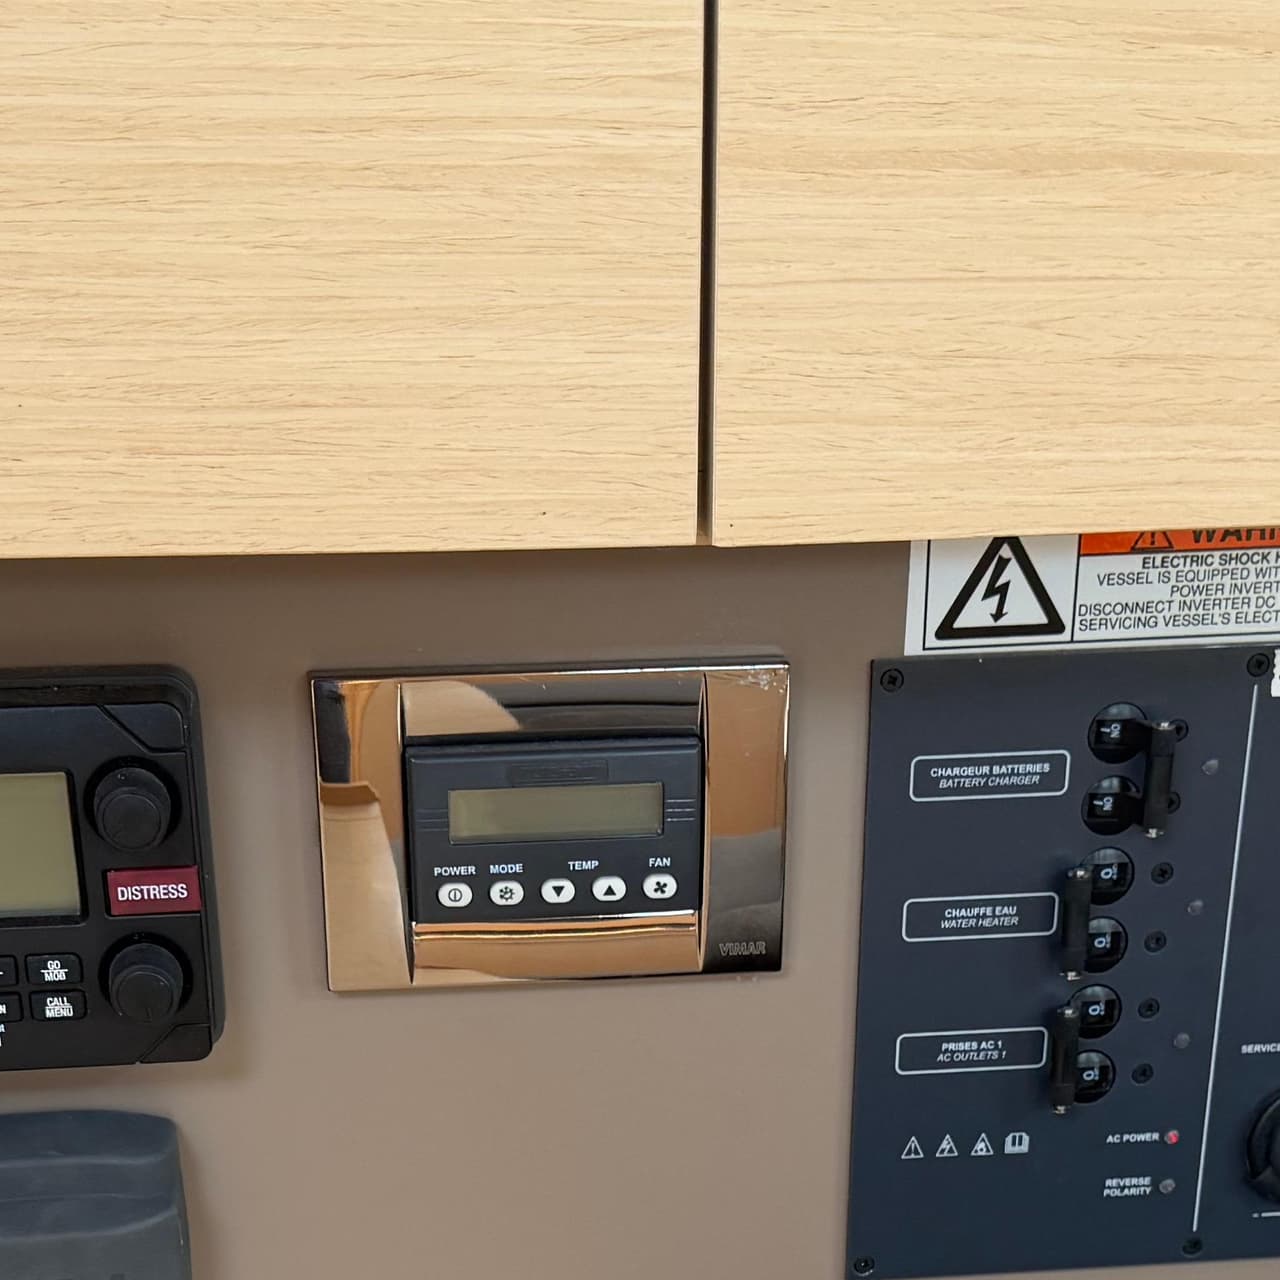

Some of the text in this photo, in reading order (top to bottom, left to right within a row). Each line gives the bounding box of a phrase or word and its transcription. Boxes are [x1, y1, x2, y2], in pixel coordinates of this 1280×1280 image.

[1141, 554, 1215, 570] ELECTRIC
[1218, 551, 1272, 567] SHOCK
[1097, 572, 1153, 587] VESSEL
[1157, 571, 1171, 585] IS
[1175, 567, 1251, 584] EQUIPPED
[1170, 583, 1225, 598] POWER
[1078, 600, 1174, 617] DISCONNECT
[1178, 596, 1251, 612] INVERTER
[1255, 596, 1276, 609] DC
[1078, 615, 1159, 632] SERVICING
[1162, 611, 1231, 628] VESSEL'S
[930, 762, 1051, 777] CHARGEUR BATTERIES
[938, 774, 1040, 789] BATTERY CHARGER
[489, 863, 524, 875] MODE
[568, 860, 600, 872] TEMP
[648, 857, 672, 868] FAN
[433, 865, 477, 877] POWER
[117, 883, 188, 902] DISTRESS
[944, 905, 1017, 918] CHAUFFE EAU
[940, 915, 1019, 929] WATER HEATER
[718, 940, 767, 957] VIMAR
[47, 960, 61, 971] GO
[44, 970, 67, 983] MOB
[46, 996, 71, 1007] CALL
[45, 1006, 74, 1019] MENU
[941, 1041, 979, 1052] PRISES
[979, 1040, 995, 1050] AC
[936, 1052, 953, 1063] AC
[952, 1050, 999, 1062] OUTLETS
[1105, 1131, 1160, 1144] AC POWER
[1104, 1175, 1153, 1188] REVERSE
[1103, 1185, 1153, 1198] POLARITY
